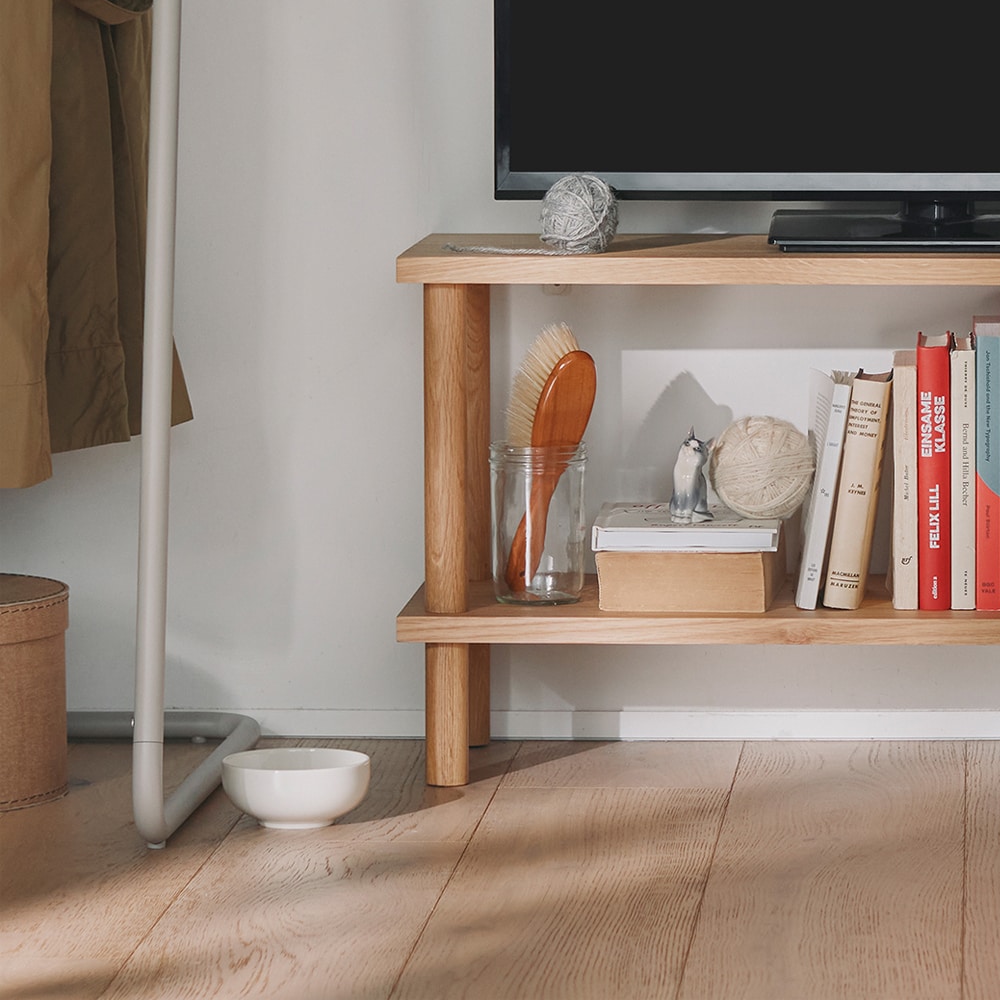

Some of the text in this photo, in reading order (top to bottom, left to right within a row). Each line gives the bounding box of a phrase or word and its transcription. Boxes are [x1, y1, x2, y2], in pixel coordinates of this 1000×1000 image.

[860, 401, 881, 409] GENERAL
[921, 391, 932, 458] EINSAME
[934, 395, 946, 453] KLASSE
[962, 423, 970, 444] Bernd
[859, 431, 878, 439] MONEY
[962, 446, 970, 460] and
[962, 461, 970, 480] Hilla
[929, 484, 940, 549] FELIX LILL
[832, 570, 860, 578] MACMILLAN
